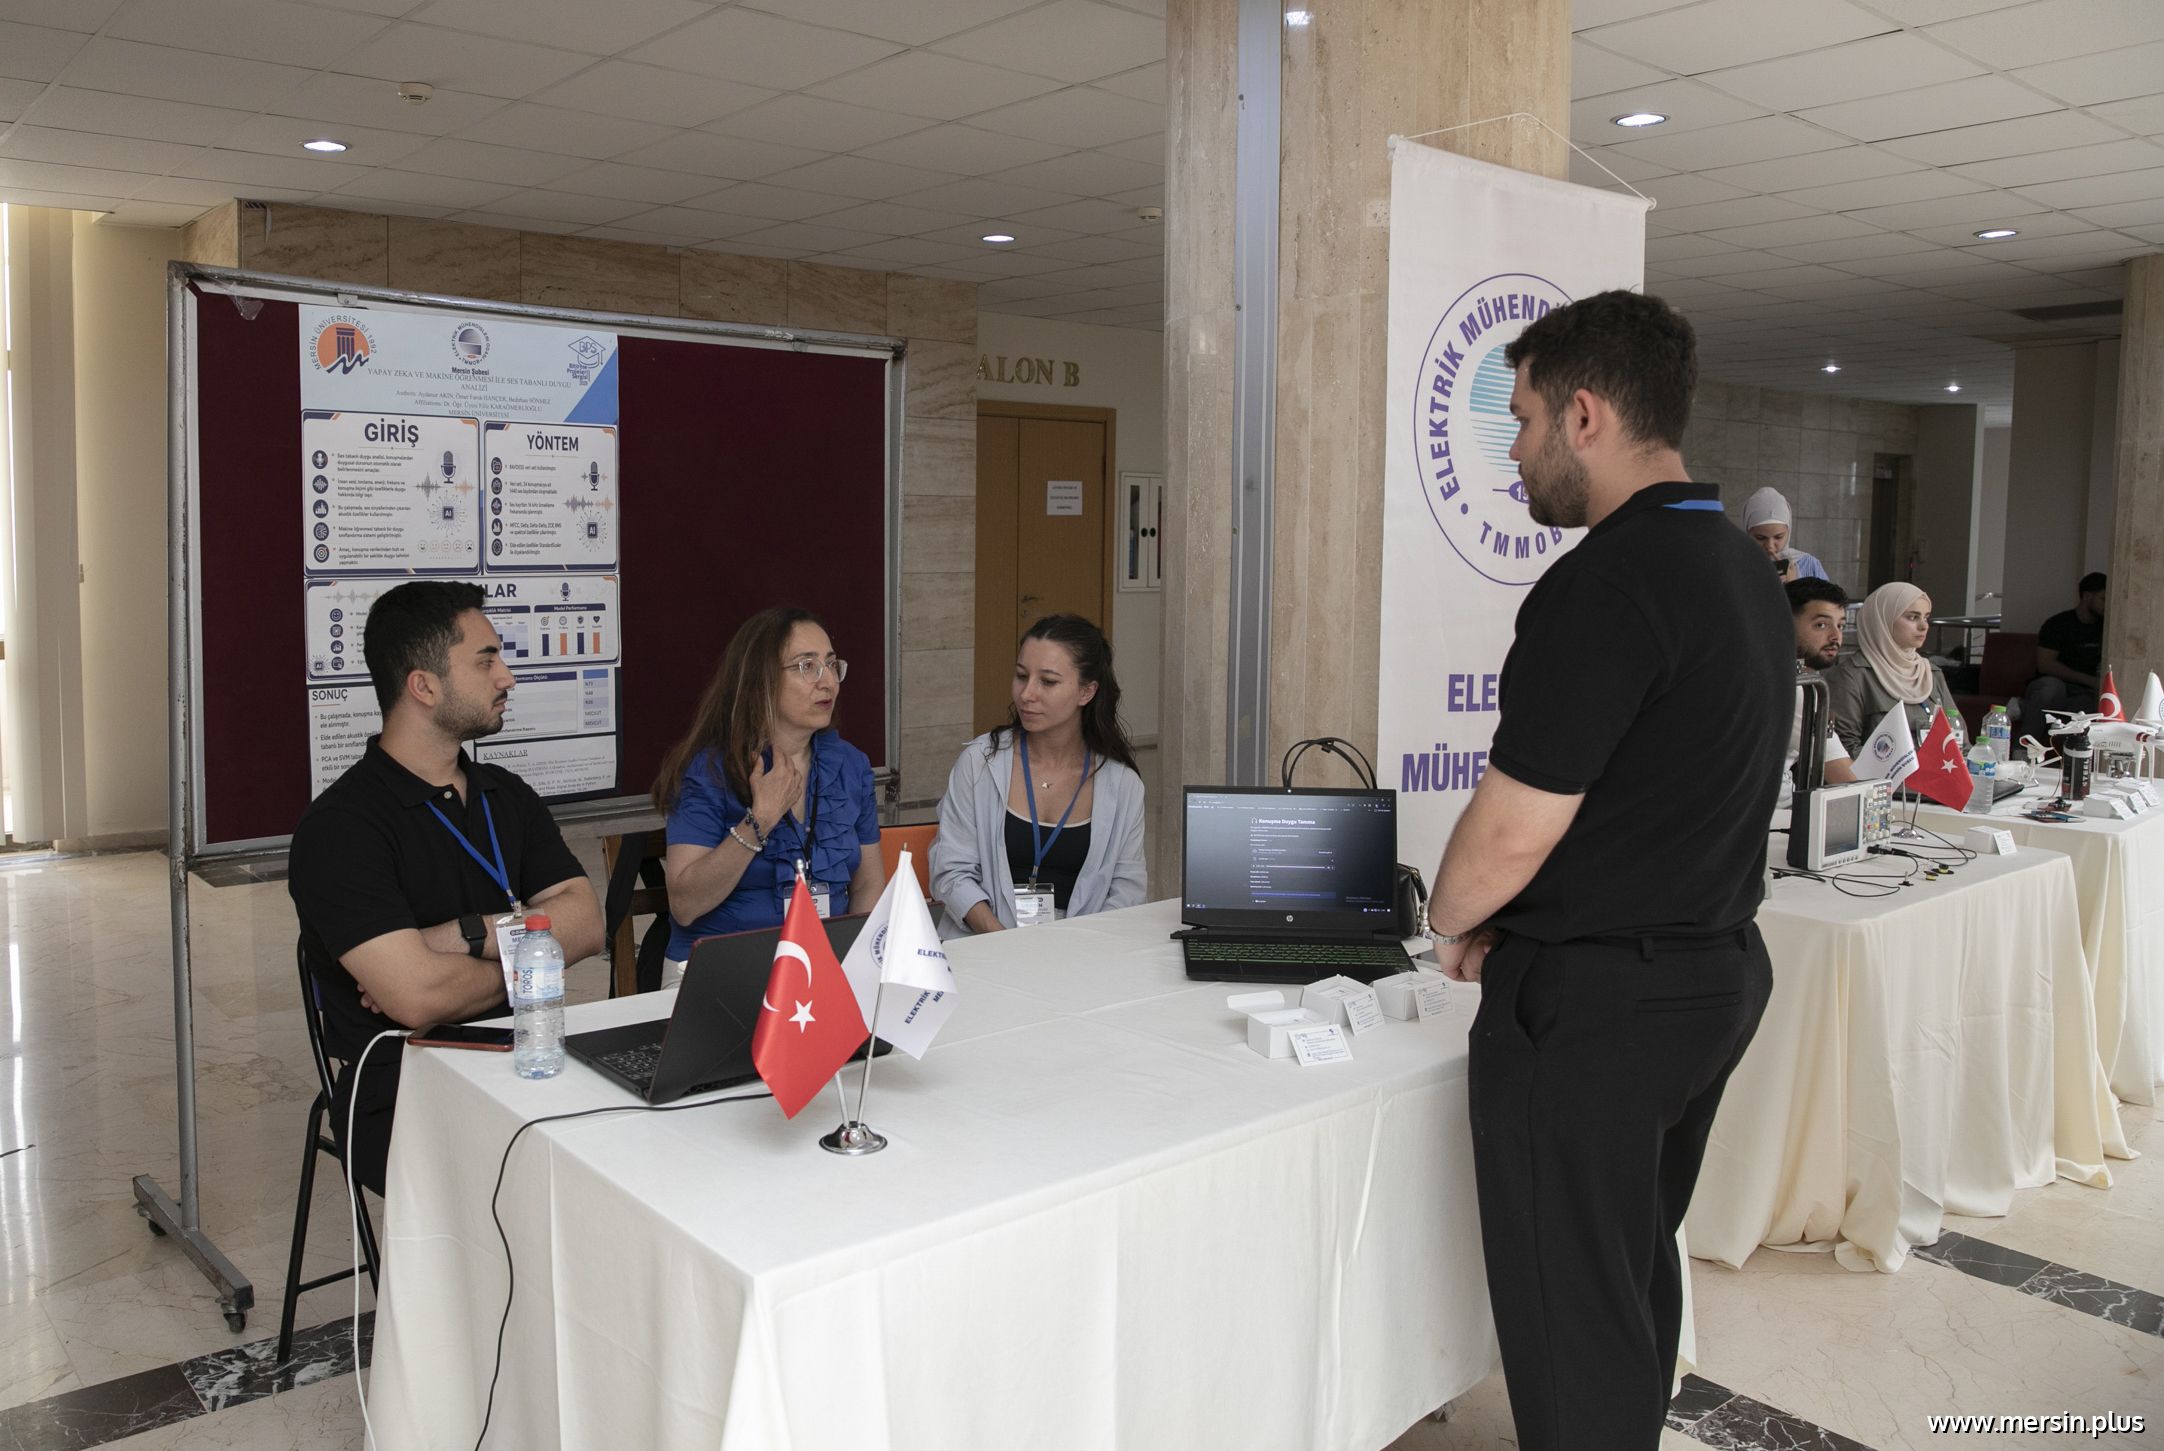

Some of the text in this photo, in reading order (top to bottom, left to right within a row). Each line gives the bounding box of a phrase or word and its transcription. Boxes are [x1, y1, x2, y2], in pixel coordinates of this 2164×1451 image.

[310, 315, 377, 369] MERSİN ÜNİVERSİTESİ 1992
[368, 368, 394, 376] YAPAY
[394, 369, 413, 377] ZEKA
[426, 371, 454, 380] MAKİNE
[455, 374, 494, 383] ÖĞRENMESİ
[494, 376, 506, 384] İLE
[520, 378, 548, 387] TABANLI
[549, 380, 571, 388] DUYGU
[461, 383, 488, 392] ANALİZİ
[1064, 362, 1079, 387] B
[1429, 294, 1556, 501] ELEKTRİK MÜHEND
[364, 418, 419, 448] GİRİŞ
[527, 431, 579, 452] YÖNTEM
[1479, 520, 1563, 559] TMMOB
[312, 689, 348, 701] SONUÇ
[1448, 674, 1500, 712] ELE
[484, 749, 528, 759] KAYNAKLAR
[1402, 743, 1488, 792] MÜHE
[873, 925, 889, 955] MÜHENDİ
[523, 969, 533, 993] TOROS
[904, 990, 930, 1024] ELEKTRİK
